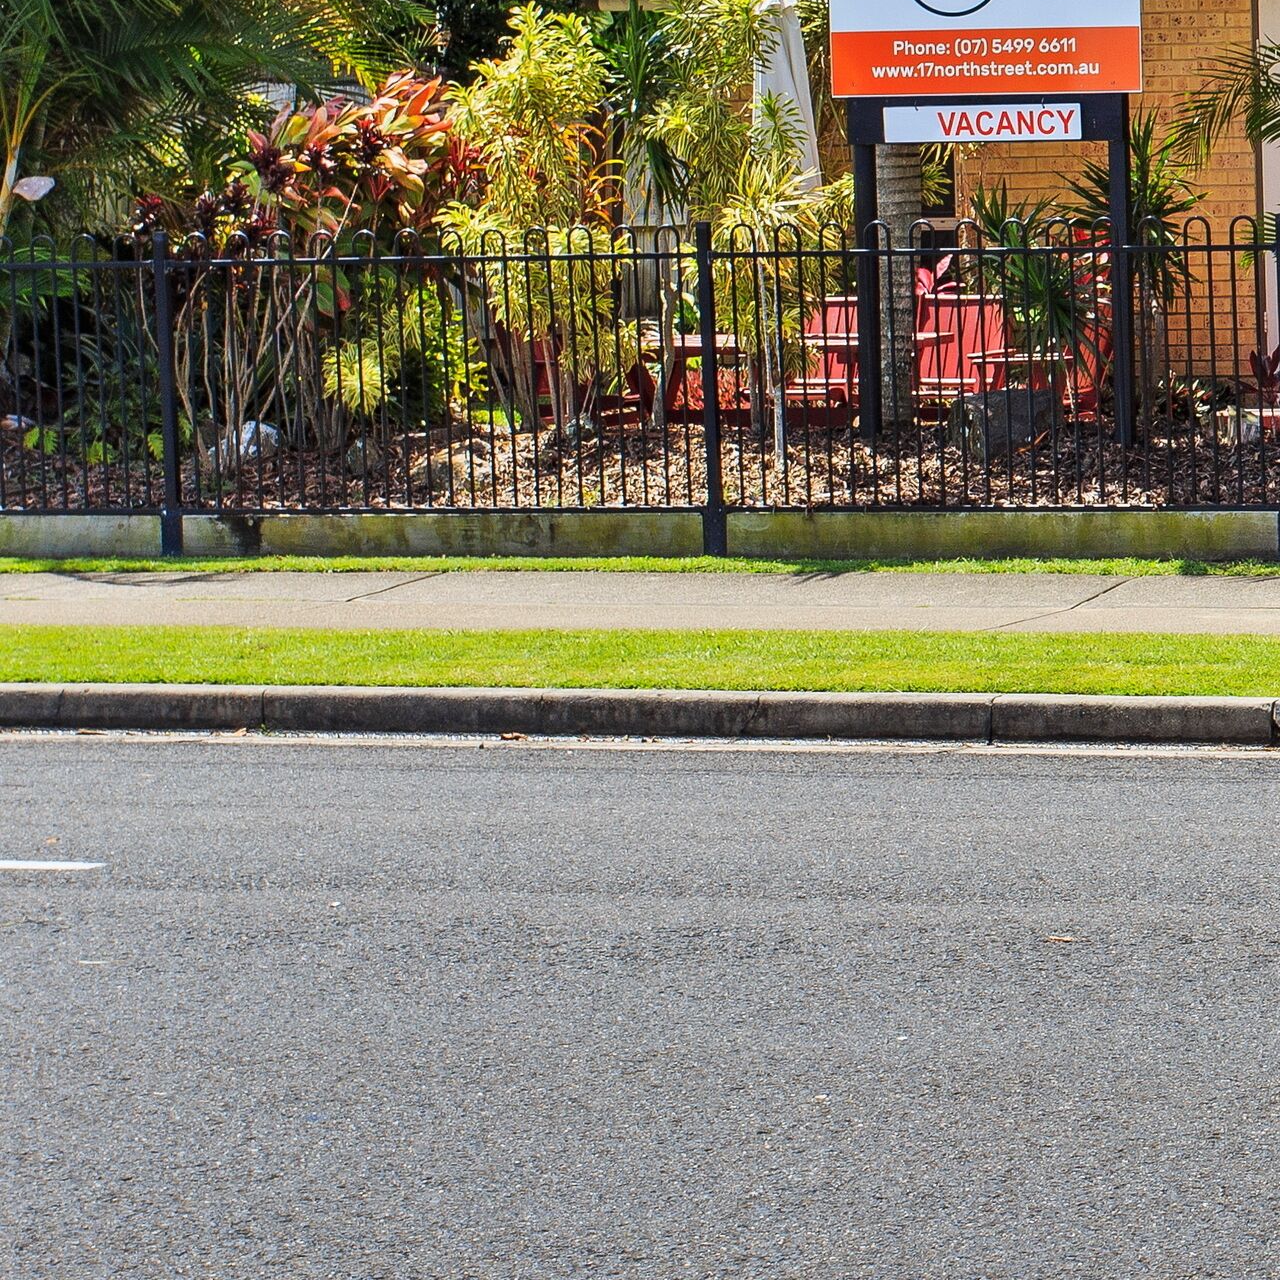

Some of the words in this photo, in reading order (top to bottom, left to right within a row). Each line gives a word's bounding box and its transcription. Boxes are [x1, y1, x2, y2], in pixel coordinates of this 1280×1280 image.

[892, 39, 951, 56] Phone:
[954, 38, 988, 57] (07)
[991, 38, 1035, 54] 5499
[1038, 37, 1077, 53] 6611
[871, 60, 1100, 78] www.17northstreet.com.au
[937, 109, 1075, 137] VACANCY
